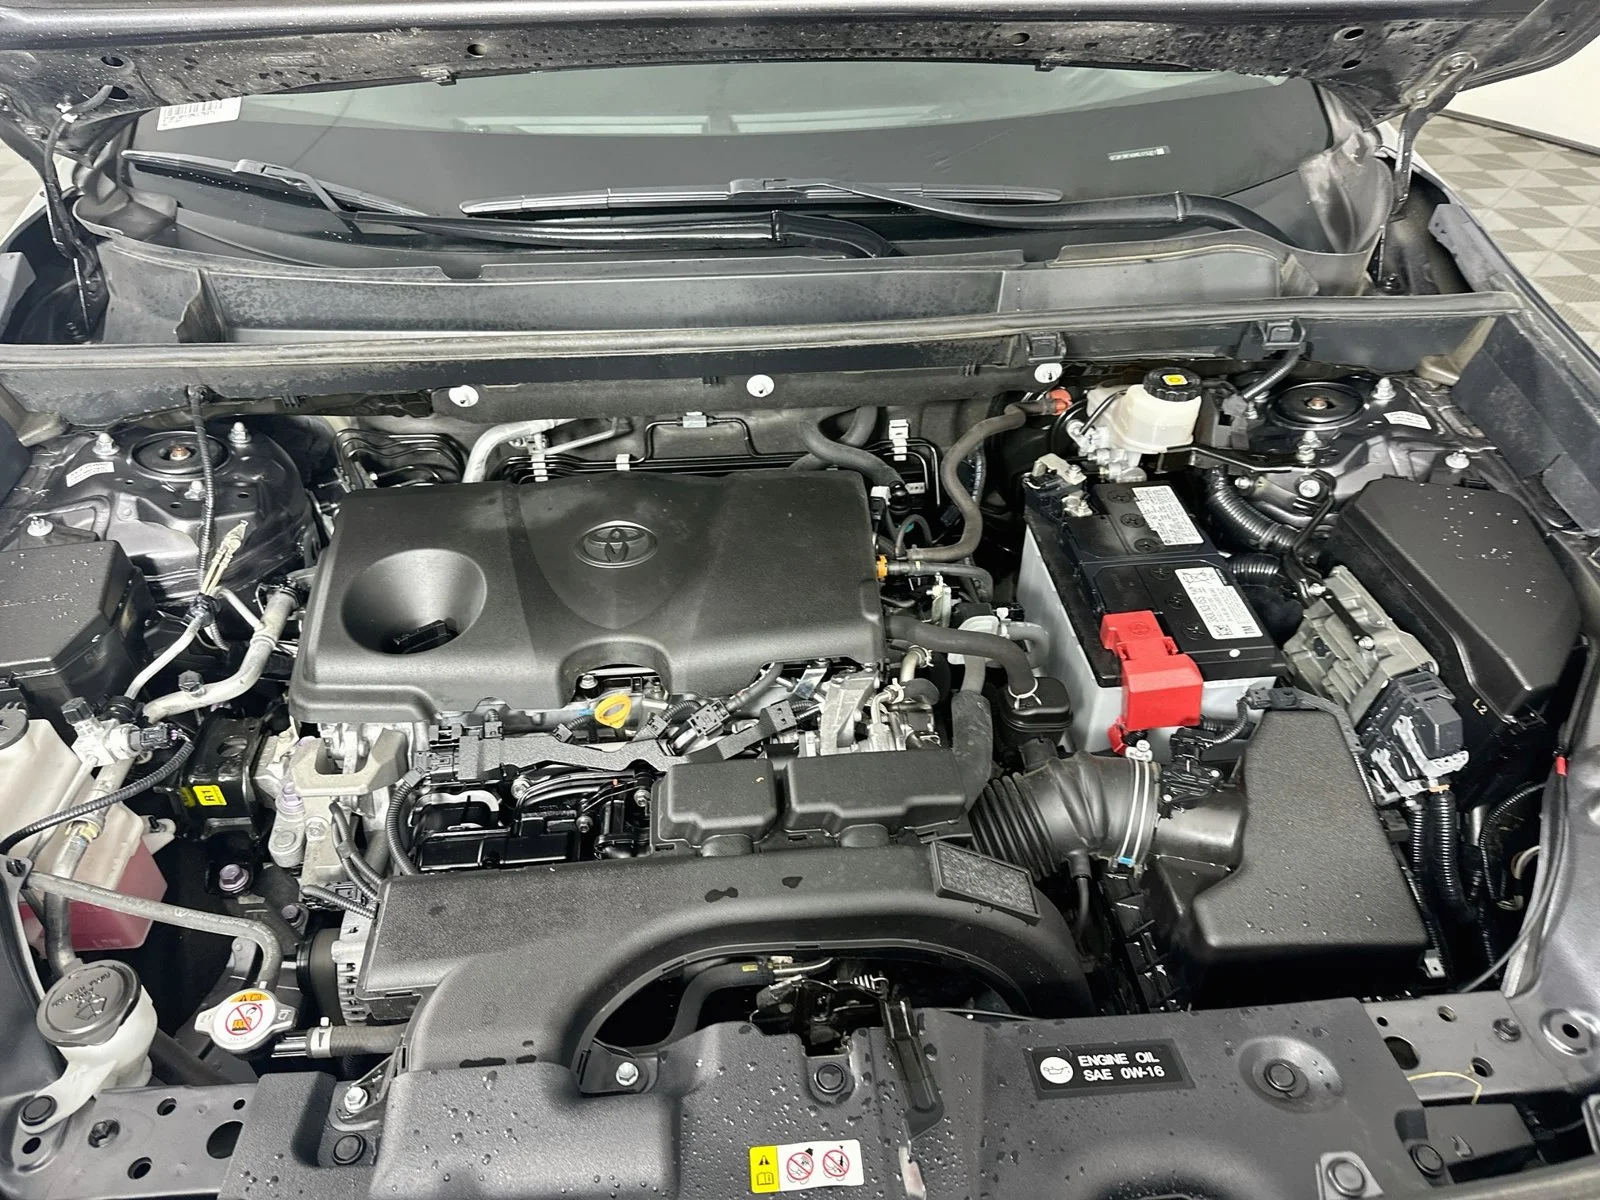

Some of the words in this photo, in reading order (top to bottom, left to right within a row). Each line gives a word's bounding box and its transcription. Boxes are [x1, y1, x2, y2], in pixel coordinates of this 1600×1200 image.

[1472, 698, 1487, 715] L2
[1078, 1053, 1130, 1067] ENGINE
[1135, 1052, 1160, 1064] OIL
[1083, 1069, 1114, 1082] SAE
[1121, 1066, 1165, 1080] 0W-16
